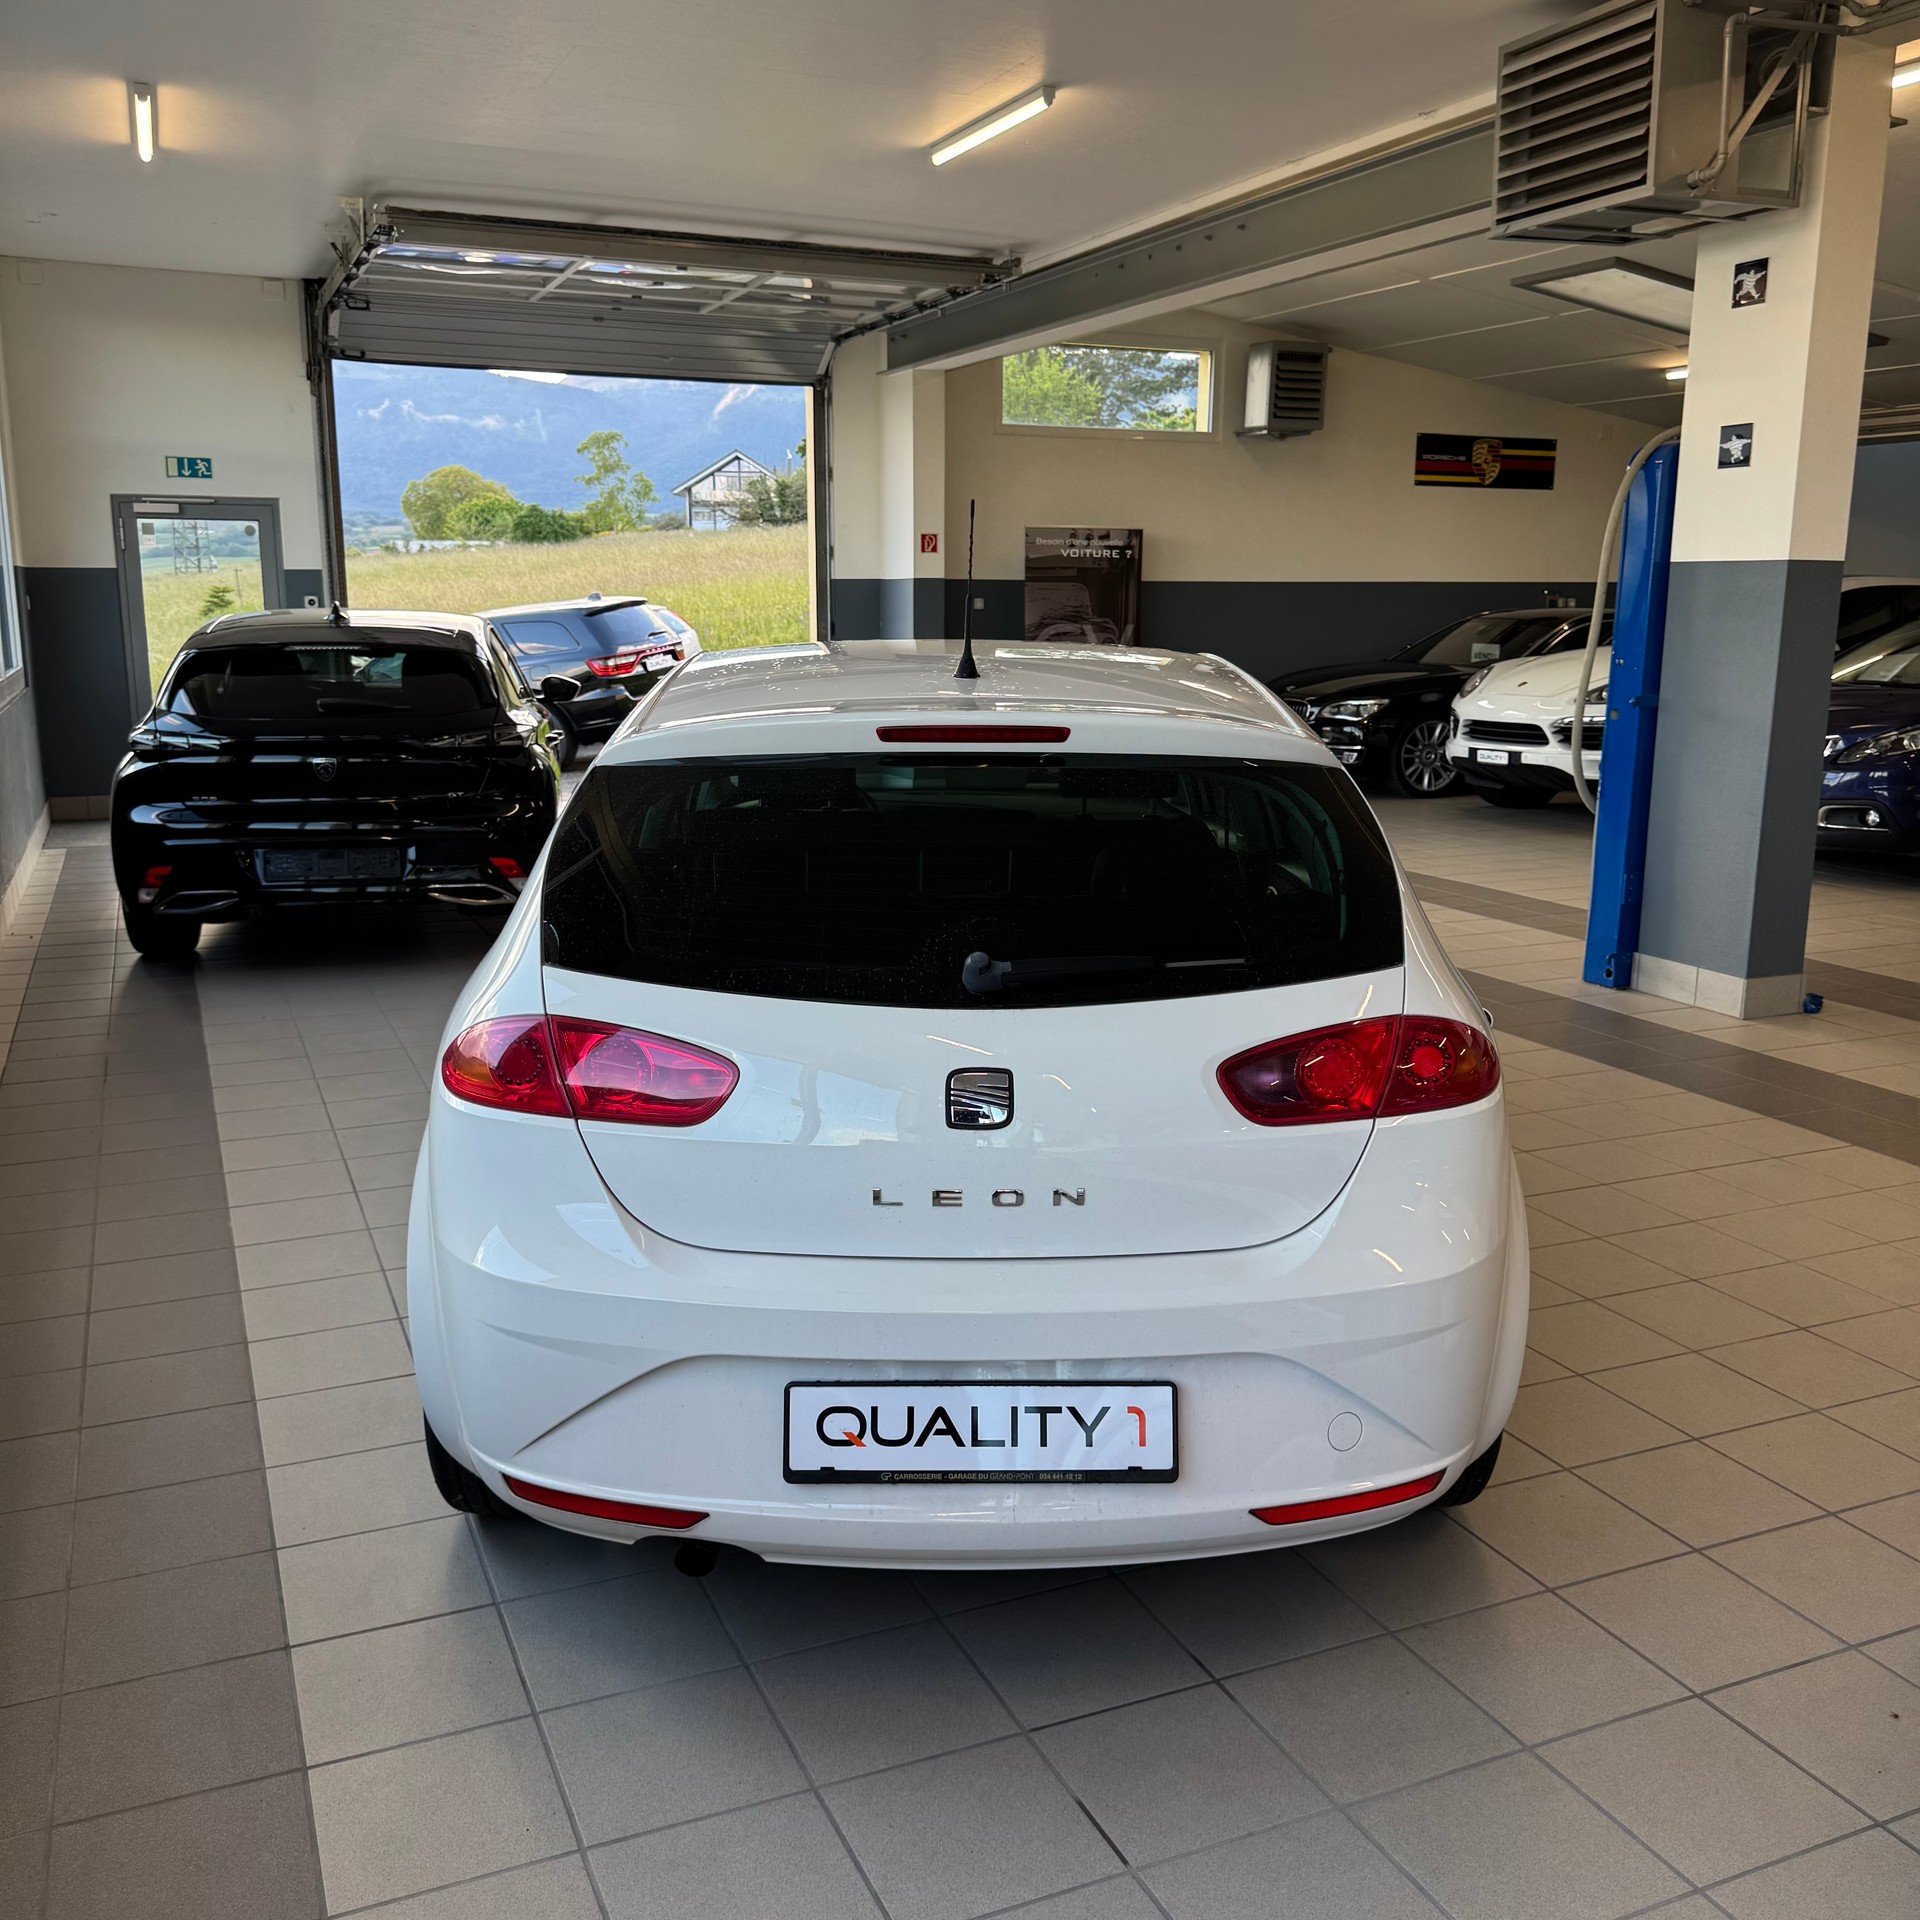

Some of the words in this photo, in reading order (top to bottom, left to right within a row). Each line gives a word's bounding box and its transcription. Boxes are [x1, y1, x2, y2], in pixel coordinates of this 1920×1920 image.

[1061, 549, 1120, 558] VOITURE
[1125, 550, 1133, 558] ?
[872, 1187, 1085, 1206] LEON
[894, 1472, 943, 1480] CARROSSERIE
[948, 1472, 977, 1480] GARAGE
[978, 1472, 989, 1480] DU
